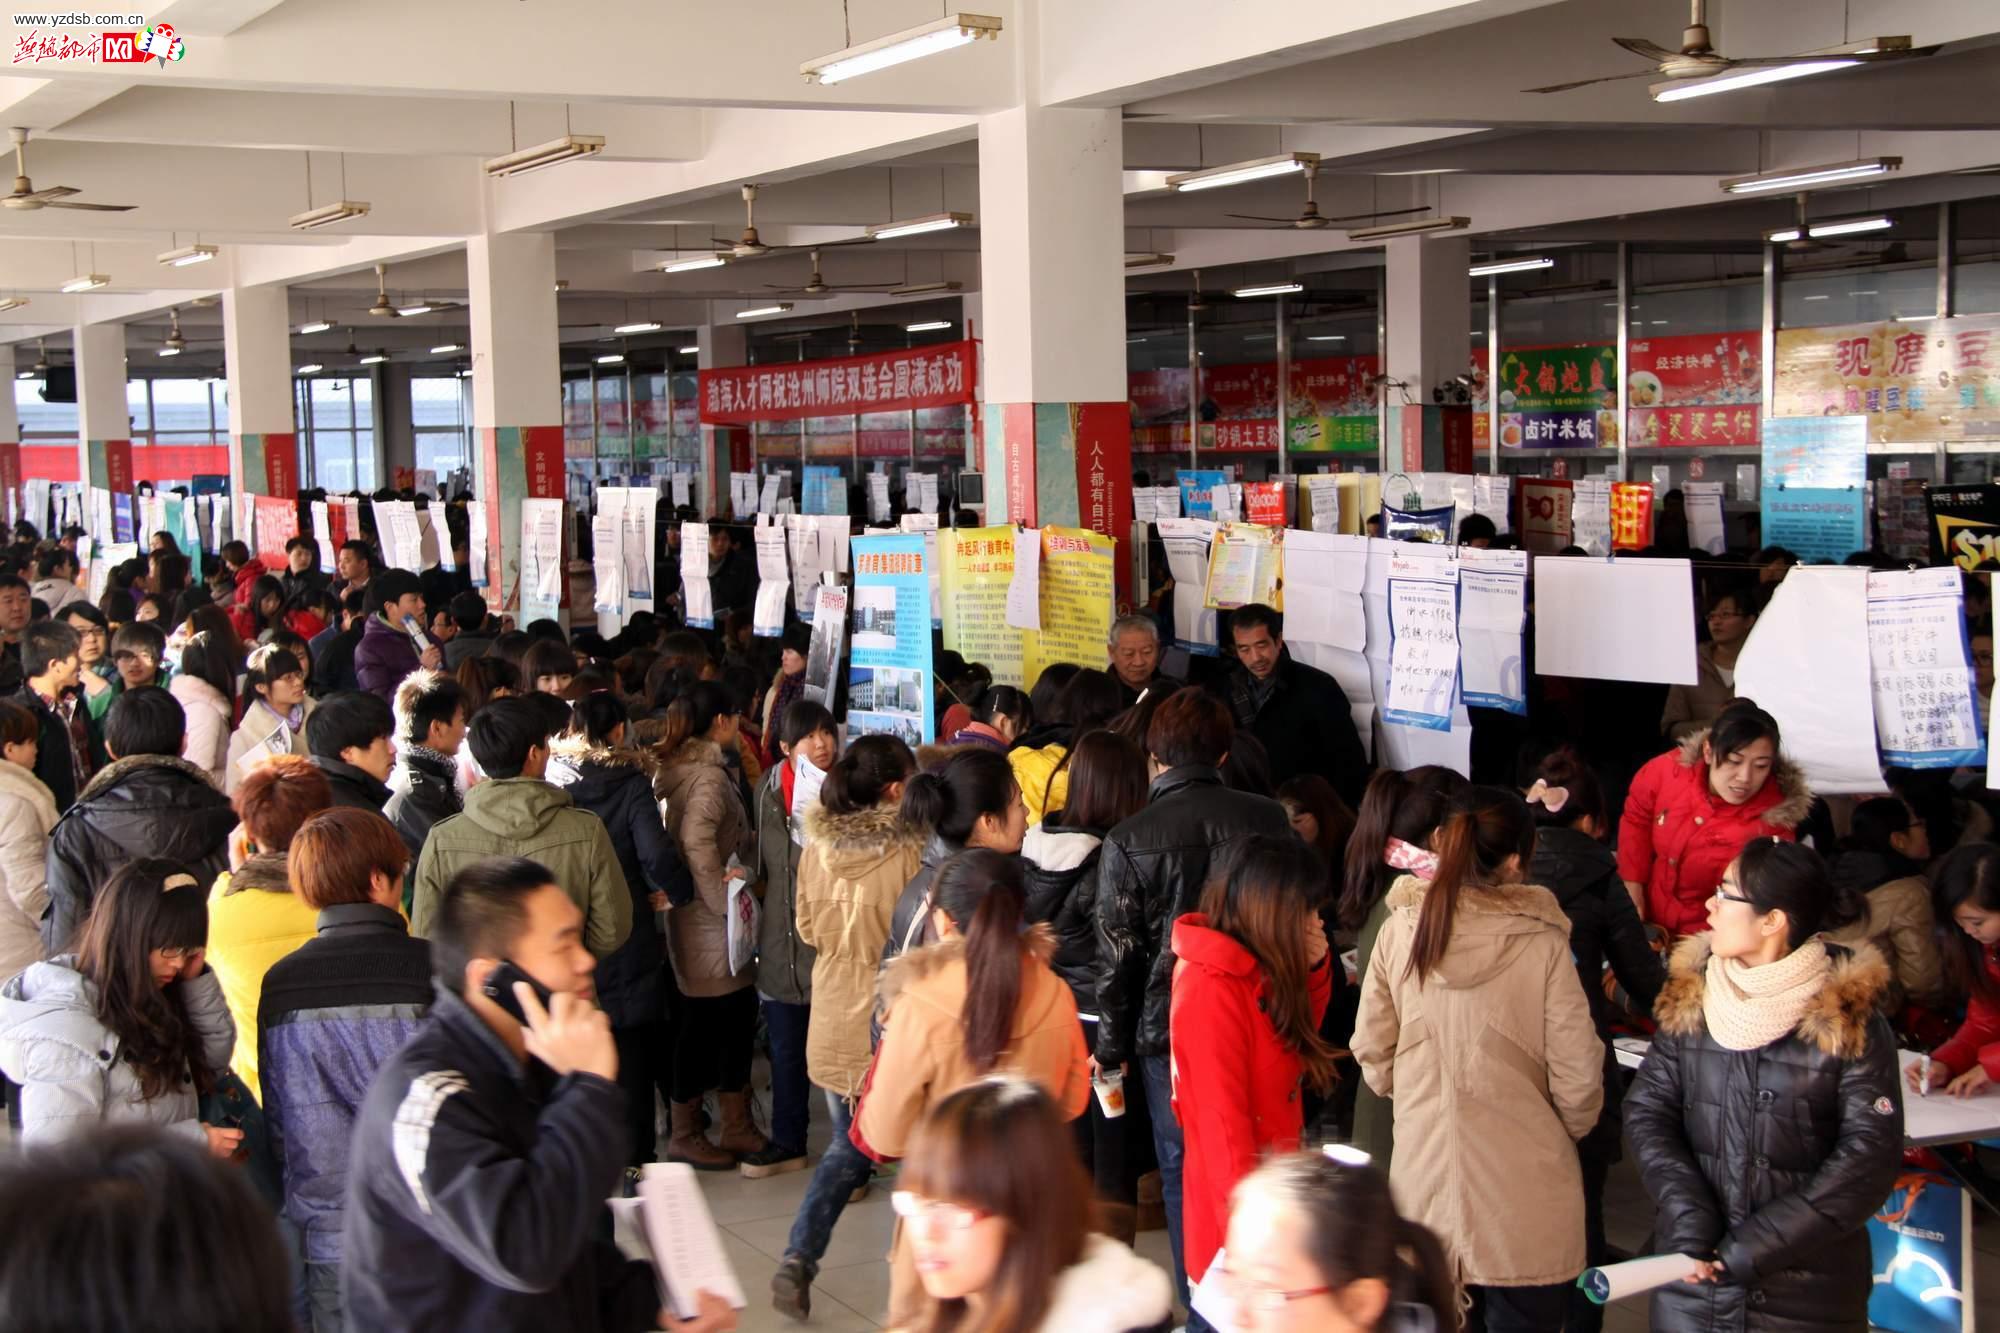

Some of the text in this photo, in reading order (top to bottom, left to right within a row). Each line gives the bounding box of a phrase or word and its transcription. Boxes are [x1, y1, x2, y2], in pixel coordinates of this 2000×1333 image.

[1217, 423, 1278, 447] 砂锅土豆粉
[1525, 418, 1594, 440] 卤汁米饭
[1090, 440, 1105, 533] 人人都有自己
